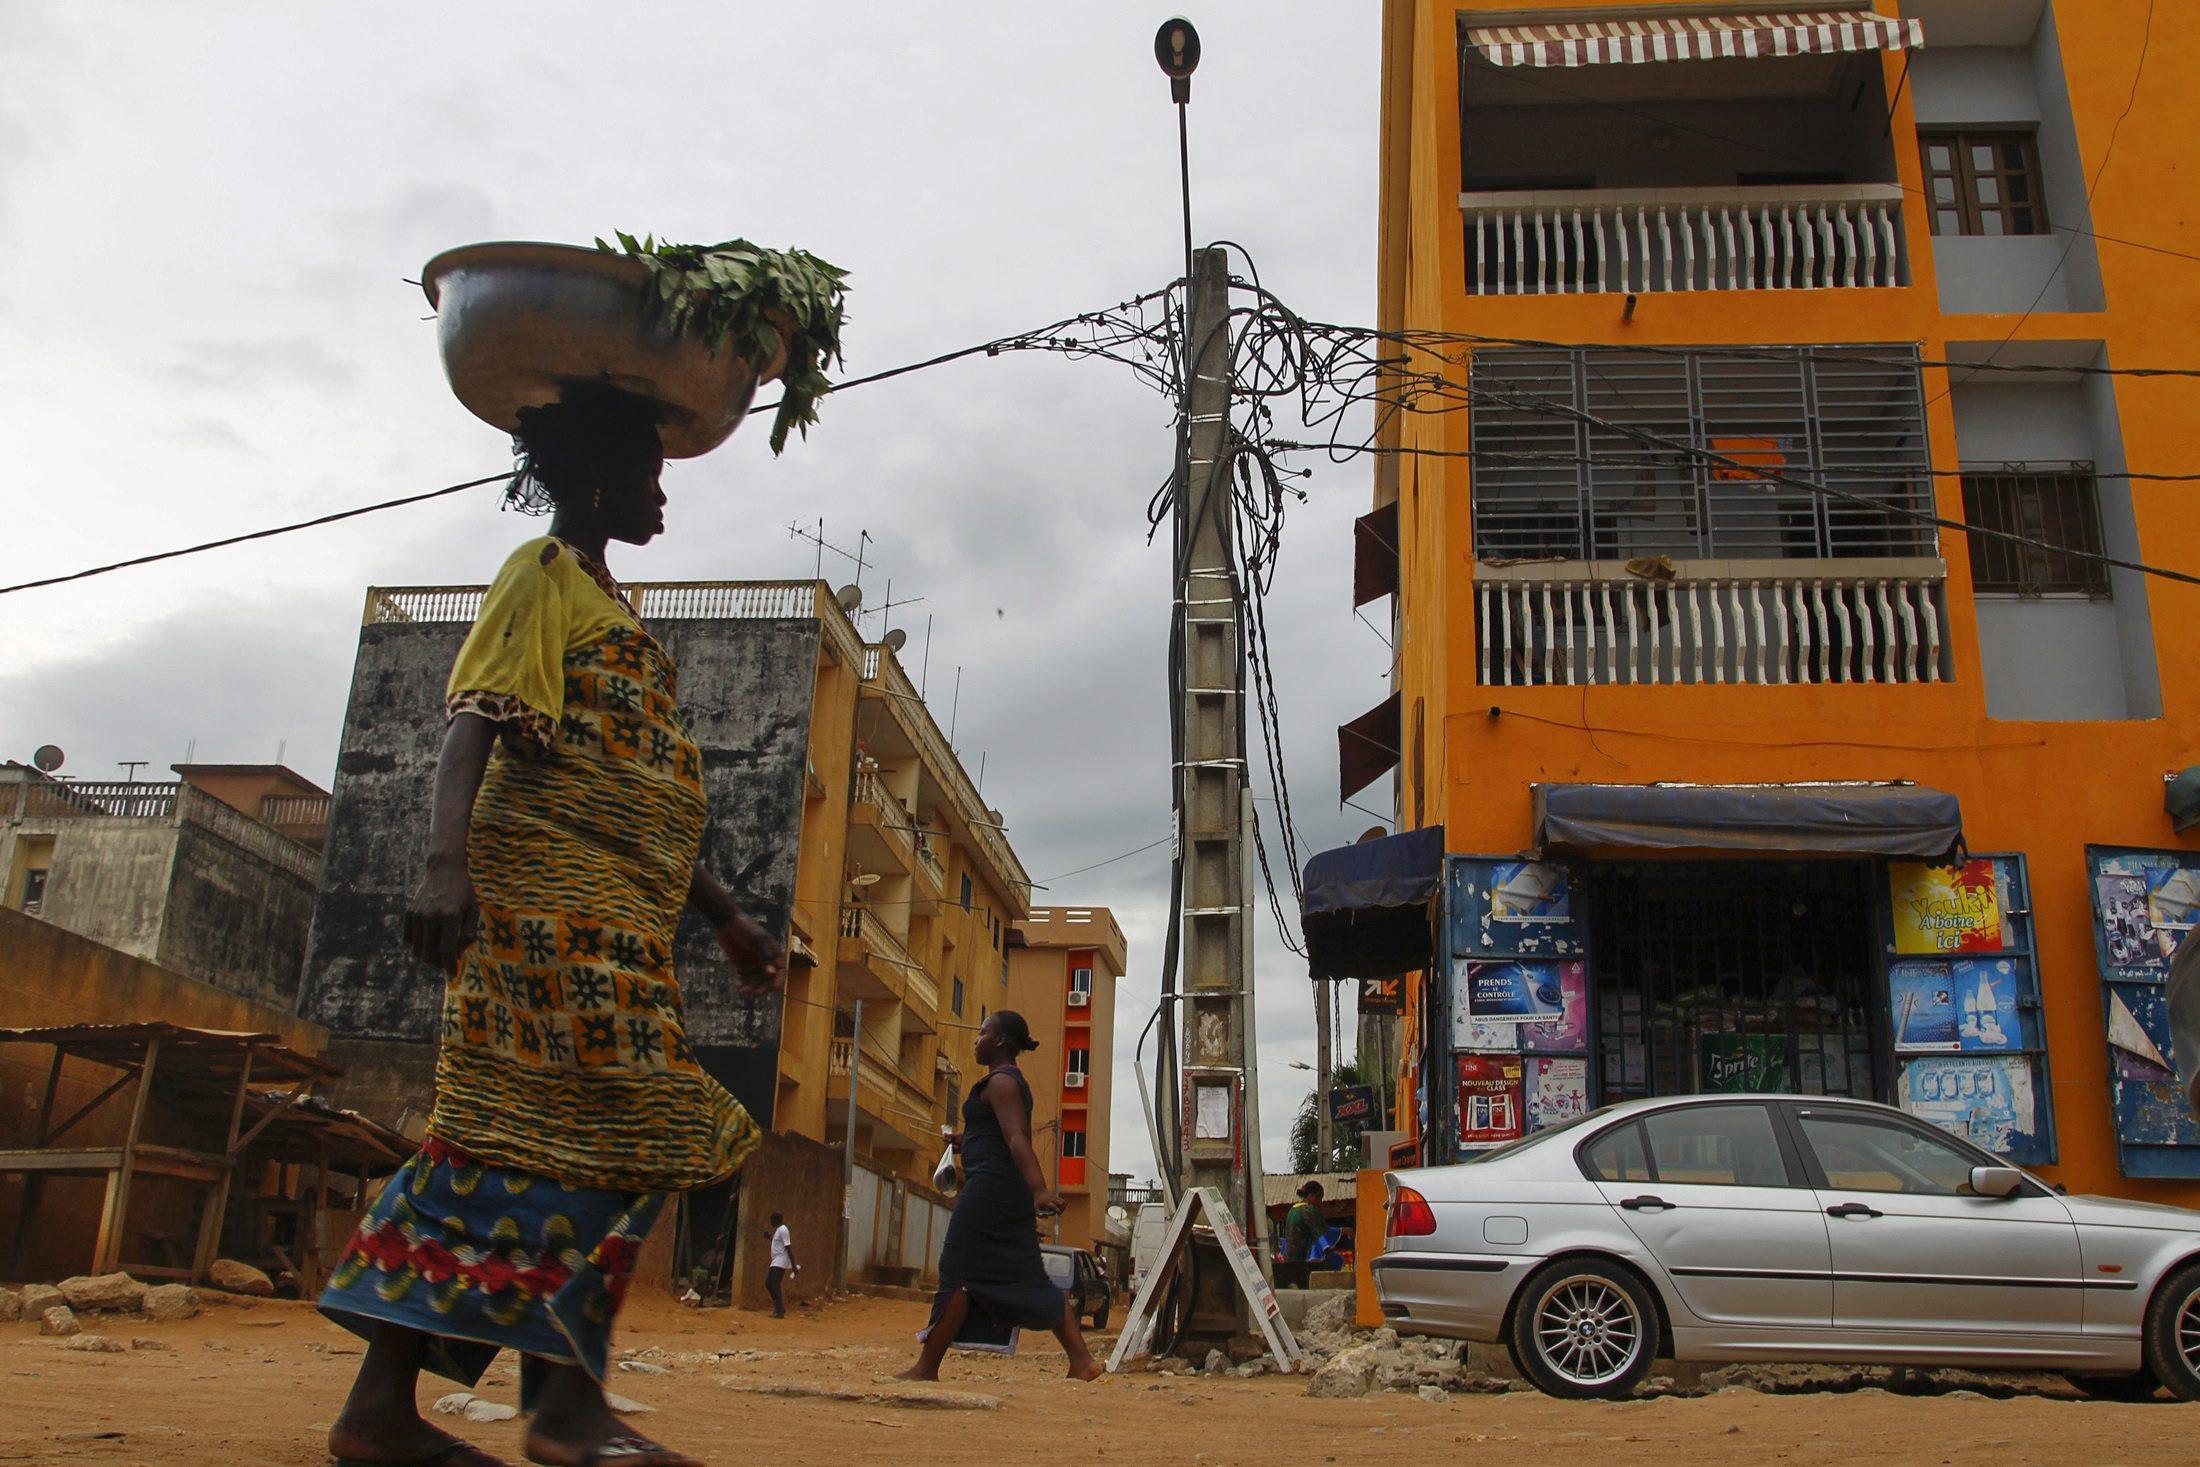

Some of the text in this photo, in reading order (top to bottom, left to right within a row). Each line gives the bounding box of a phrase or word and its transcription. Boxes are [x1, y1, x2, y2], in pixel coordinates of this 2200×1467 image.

[1920, 911, 1974, 929] A boire
[1937, 931, 1961, 949] ici
[1714, 1053, 1758, 1078] Sprite
